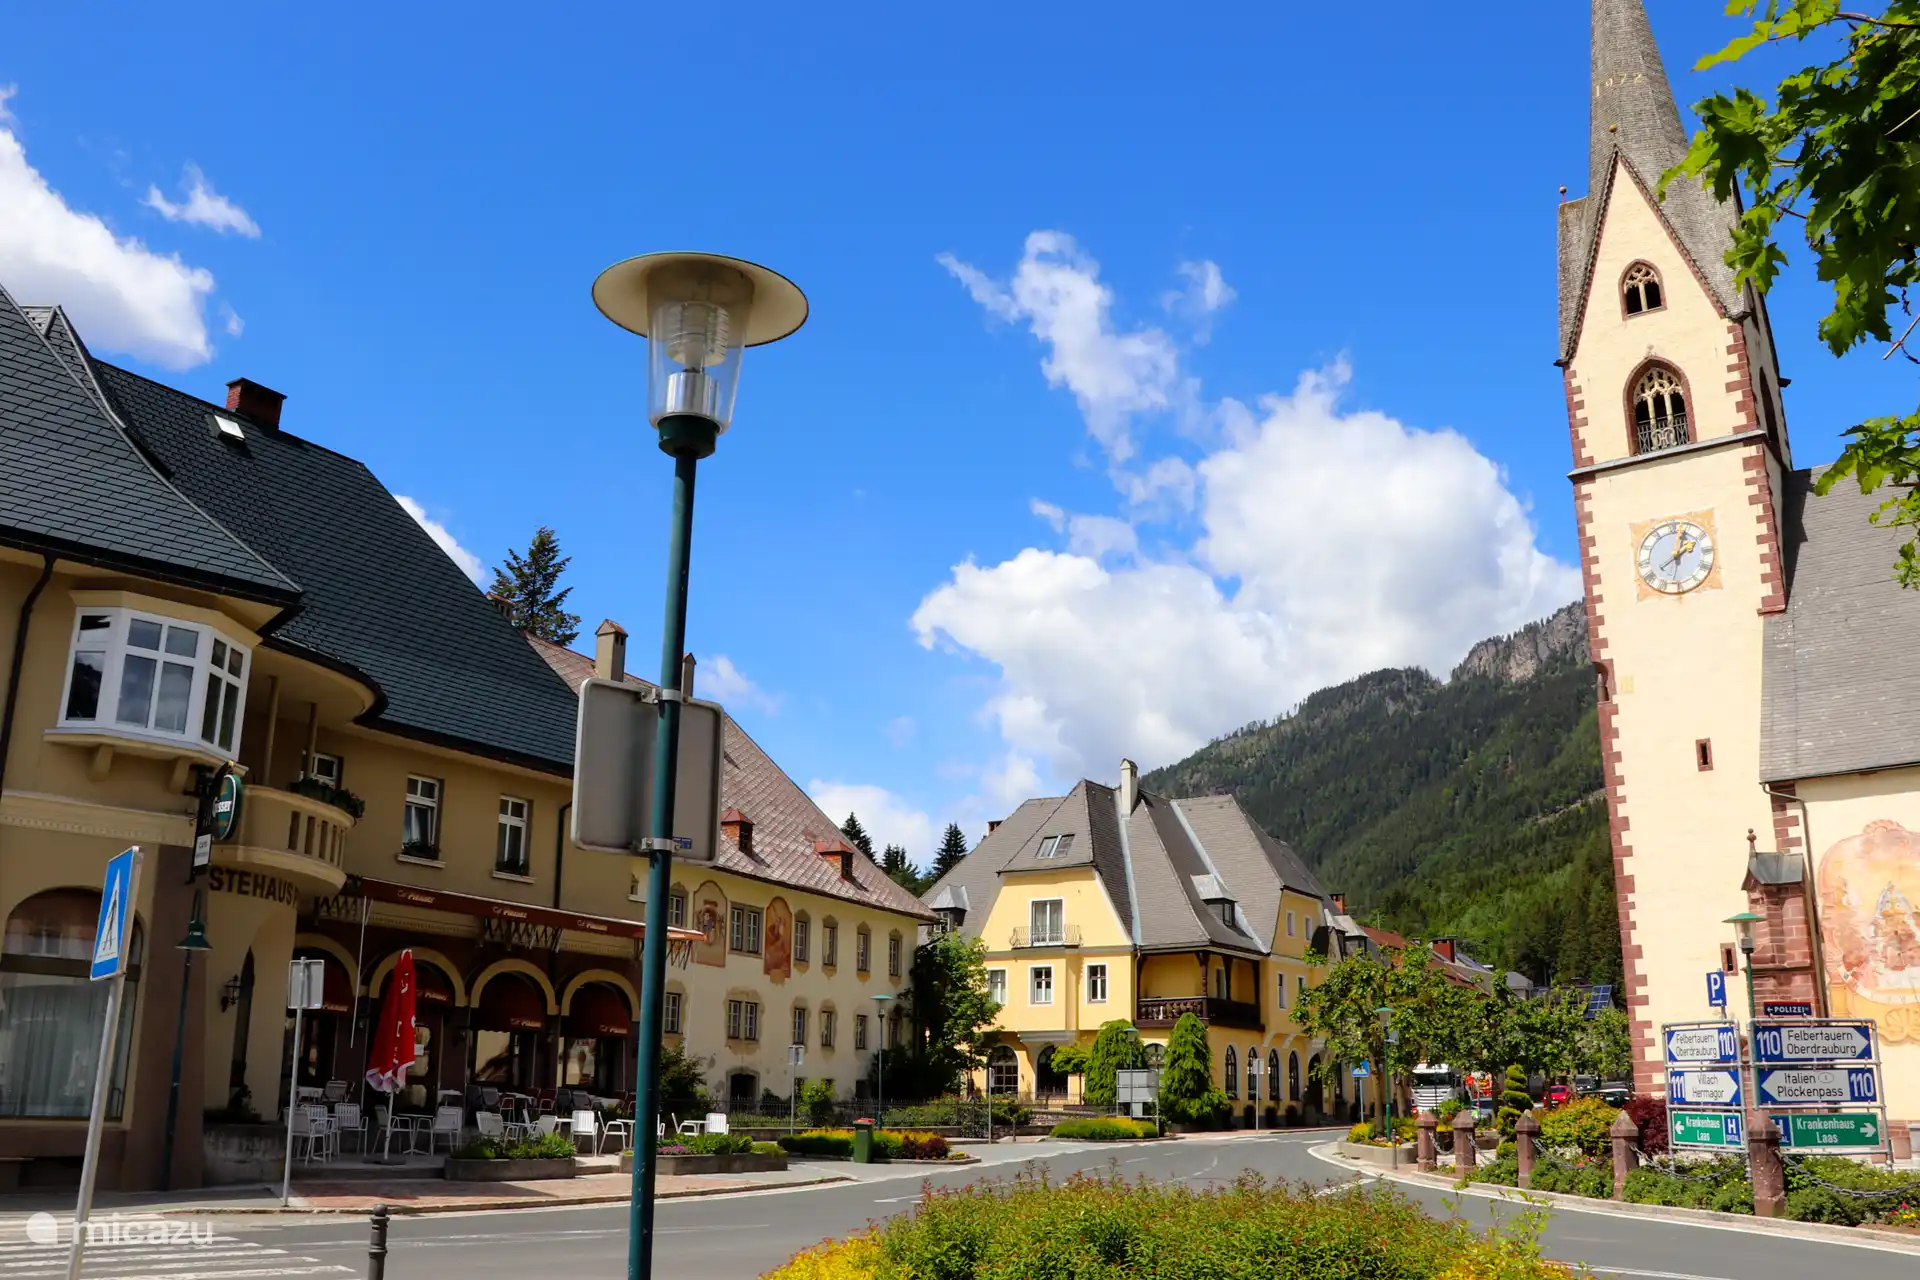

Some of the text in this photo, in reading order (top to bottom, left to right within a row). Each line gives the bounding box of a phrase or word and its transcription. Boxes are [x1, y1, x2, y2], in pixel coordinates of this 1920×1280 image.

[1676, 1033, 1715, 1044] Felbertauern
[1787, 1029, 1853, 1041] Felbertauern
[1720, 1032, 1735, 1056] 110
[1757, 1031, 1781, 1056] 110
[1786, 1043, 1857, 1057] Oberdrauburg
[1676, 1046, 1717, 1058] Oberdrauburg
[1697, 1074, 1719, 1085] Villach
[1784, 1072, 1816, 1084] Italien
[1850, 1072, 1874, 1097] 110
[1671, 1075, 1685, 1099] 111
[1777, 1086, 1844, 1099] Plöckenpass
[1692, 1088, 1725, 1101] Hermagor
[1685, 1116, 1720, 1129] Krankenhaus
[1727, 1118, 1737, 1134] H
[1797, 1117, 1856, 1130] Krankenhaus
[1697, 1129, 1710, 1141] Laas
[1816, 1131, 1839, 1144] Laas
